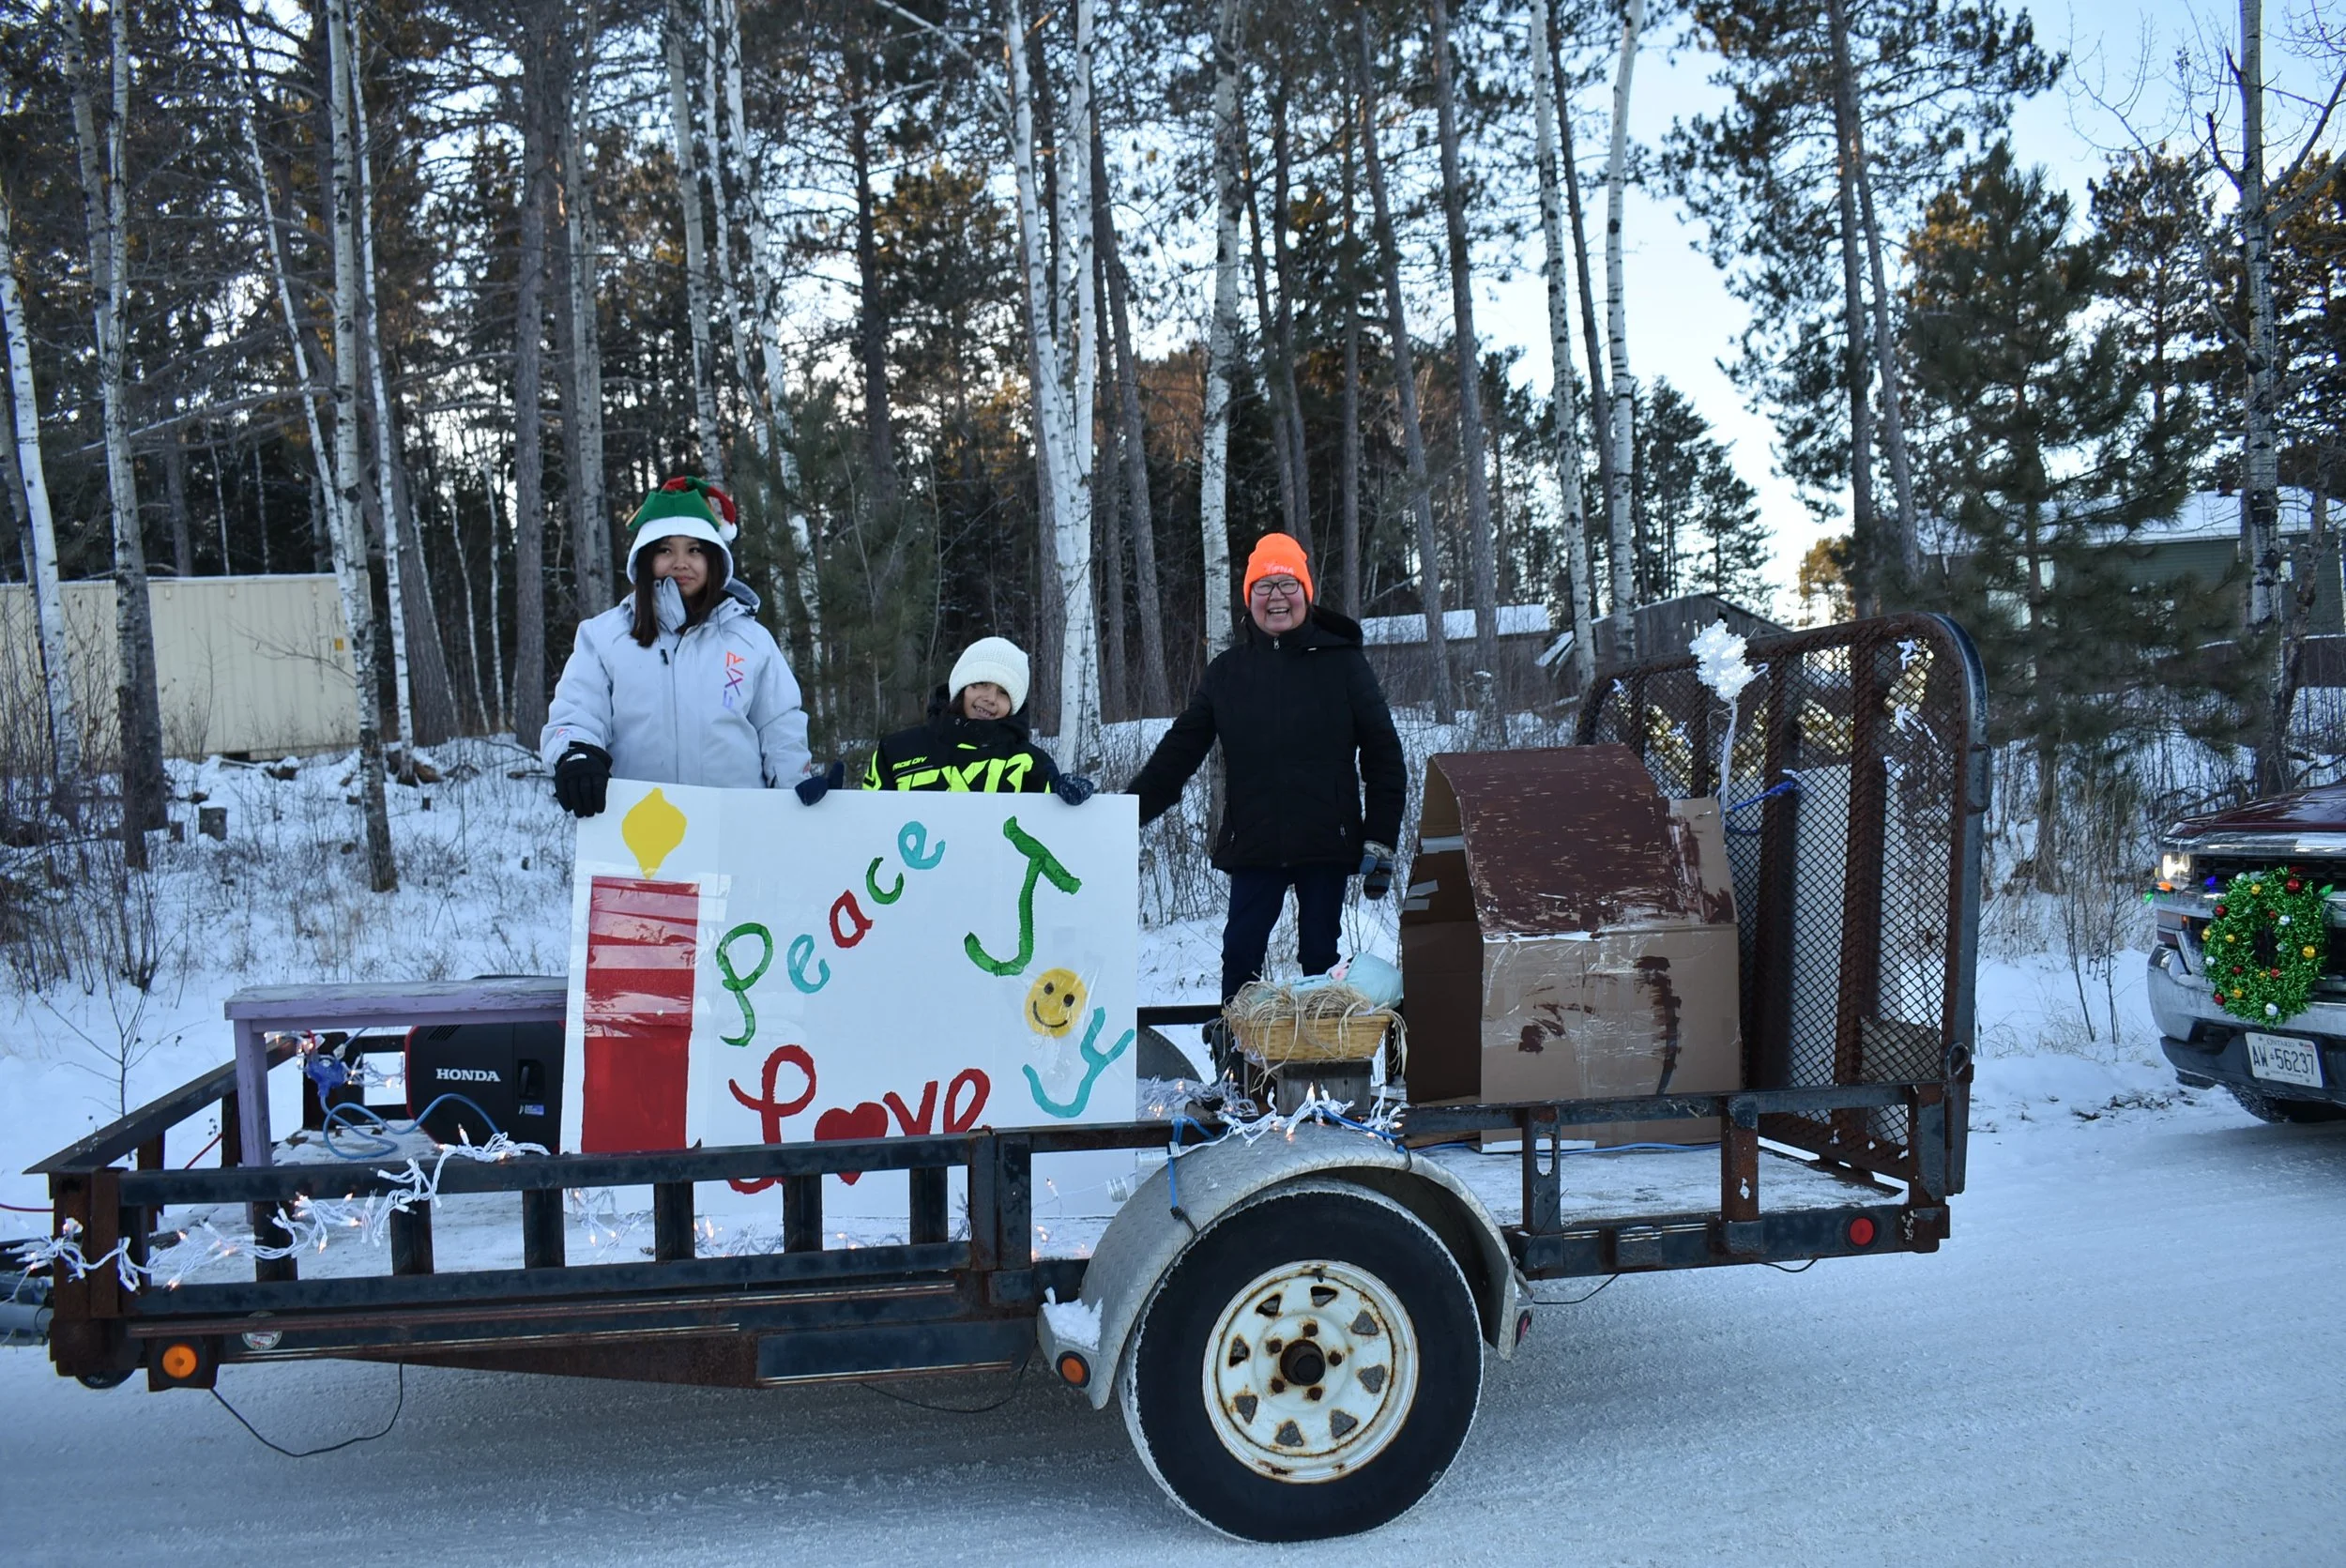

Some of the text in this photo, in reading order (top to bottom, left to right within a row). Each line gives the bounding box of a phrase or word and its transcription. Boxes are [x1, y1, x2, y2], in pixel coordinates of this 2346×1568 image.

[716, 820, 947, 1047] Peace
[2266, 1037, 2295, 1048] ONTARIO
[435, 1068, 501, 1082] HONDA
